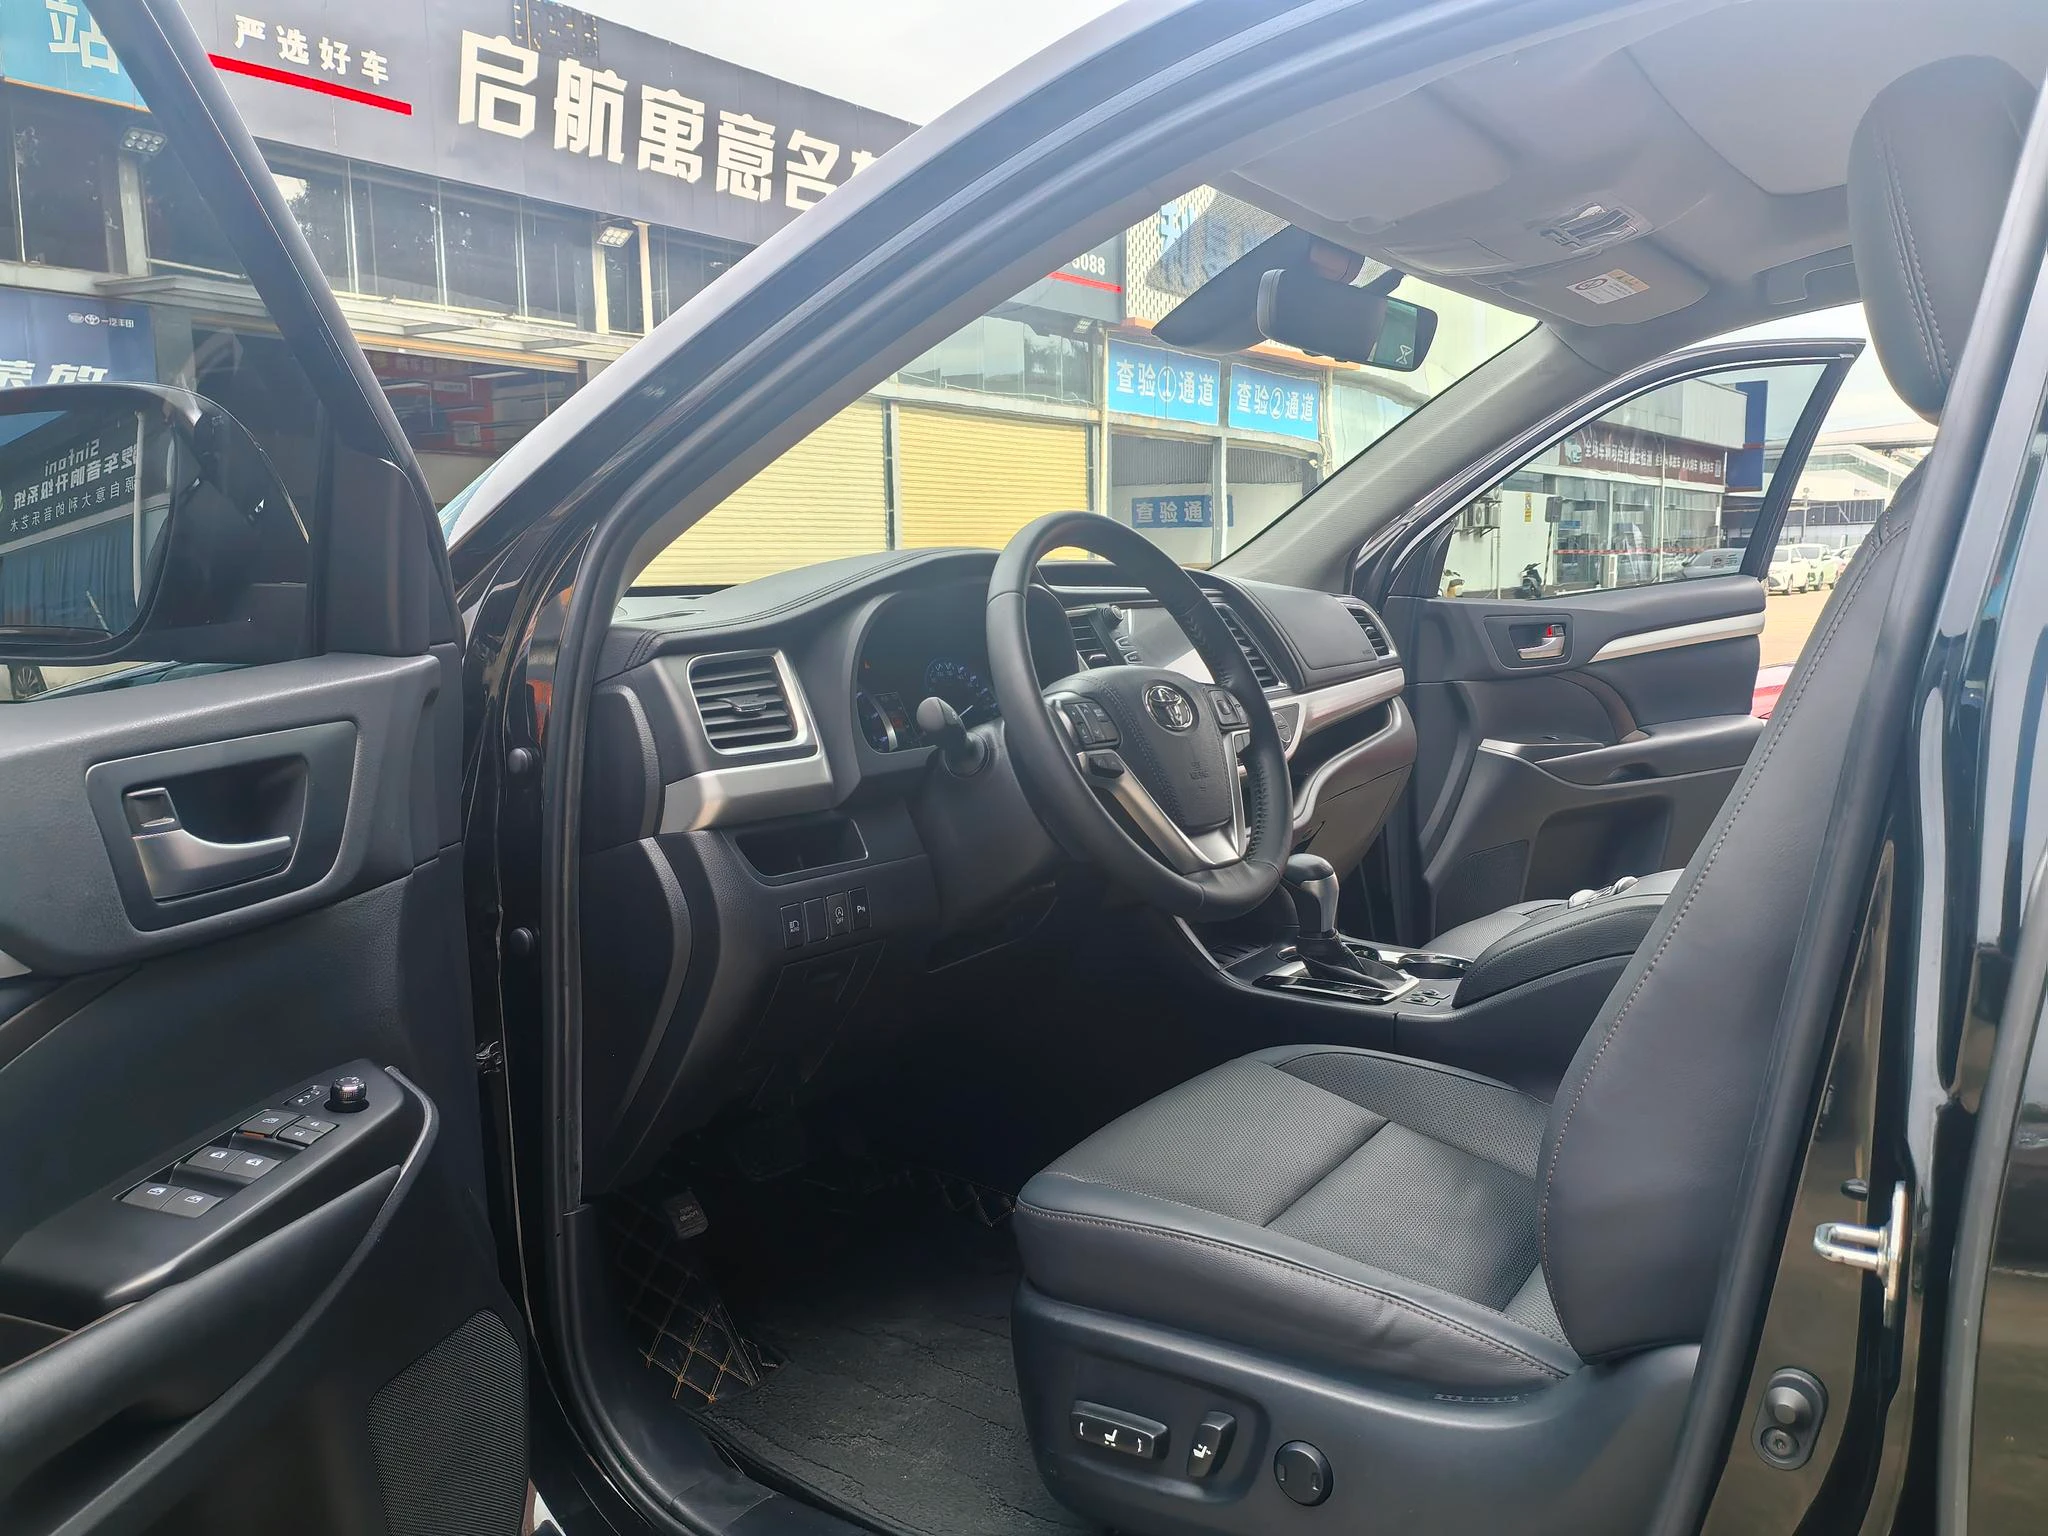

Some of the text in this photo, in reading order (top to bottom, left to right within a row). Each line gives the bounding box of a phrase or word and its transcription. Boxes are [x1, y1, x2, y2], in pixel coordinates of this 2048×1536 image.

[46, 0, 119, 74] 站
[234, 14, 390, 85] 严选好车
[458, 30, 880, 210] 启航寓意名
[1136, 501, 1213, 523] 查验通
